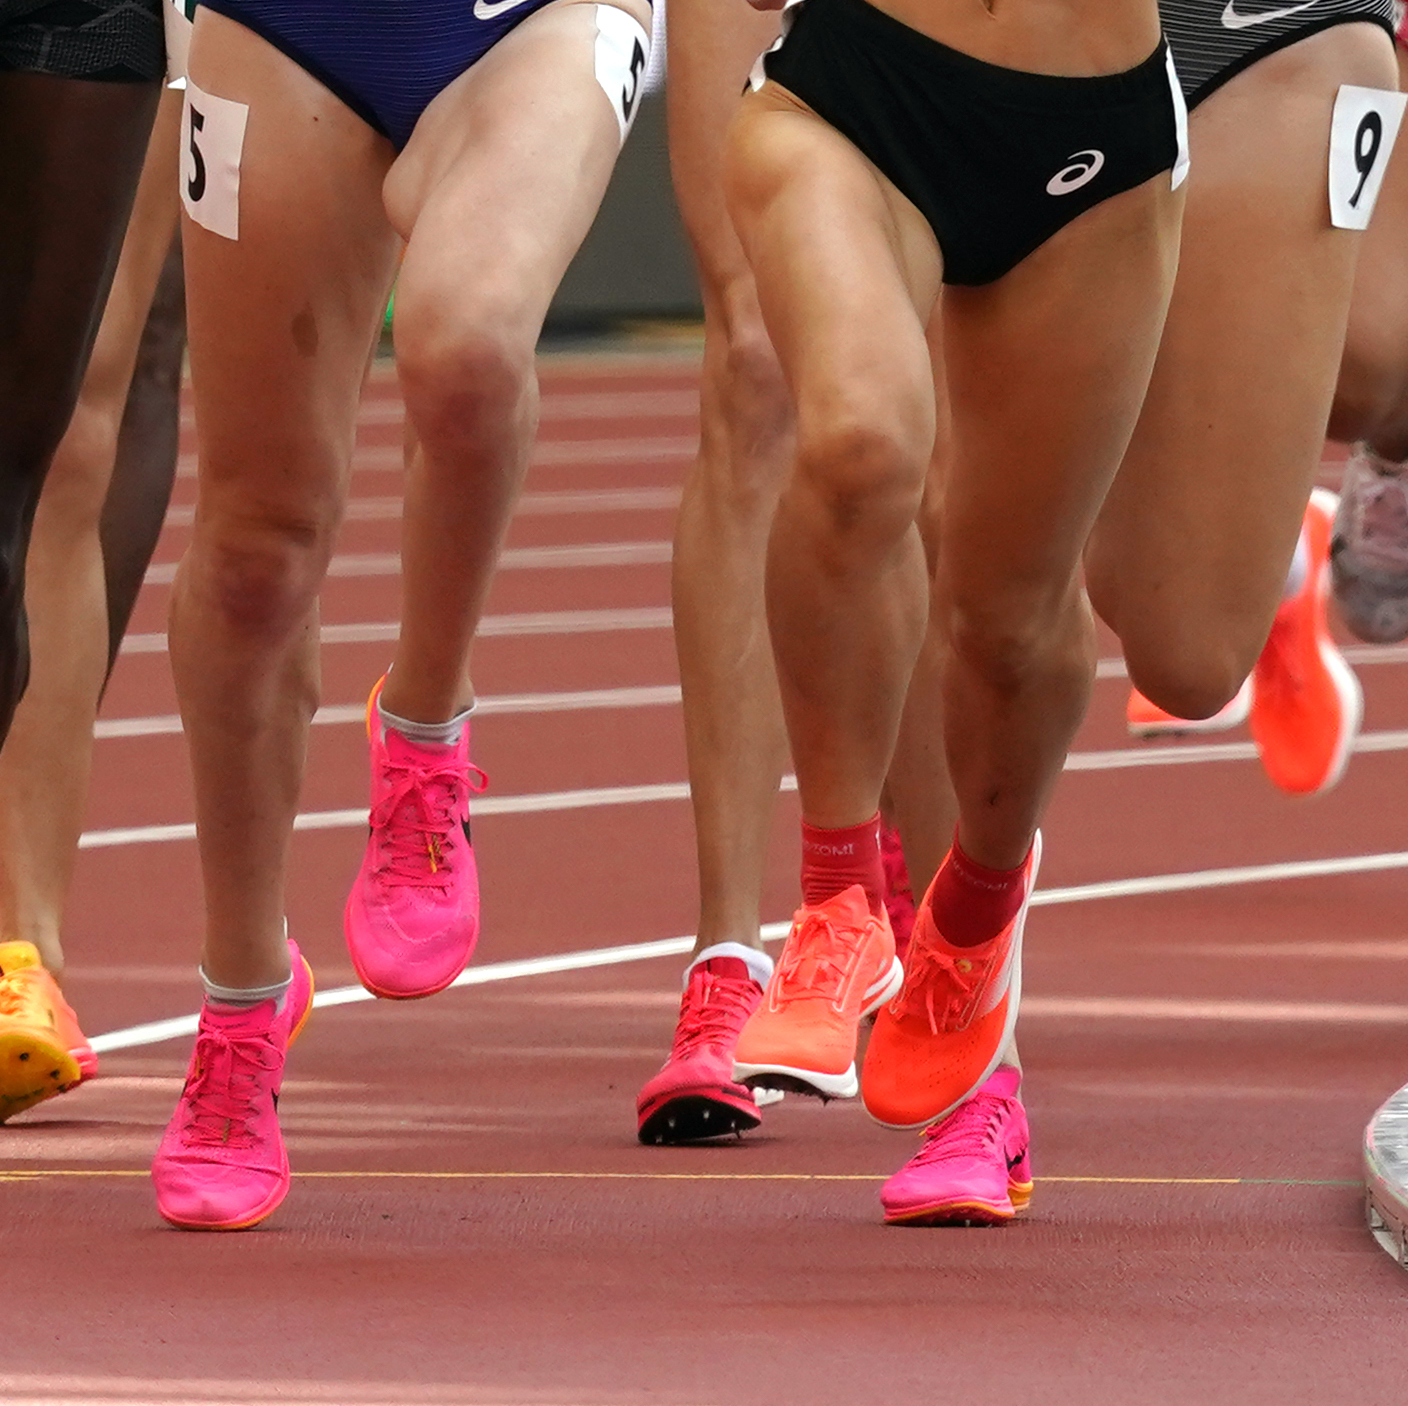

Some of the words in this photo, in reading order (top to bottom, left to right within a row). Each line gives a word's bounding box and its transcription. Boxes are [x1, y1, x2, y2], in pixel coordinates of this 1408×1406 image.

[622, 36, 645, 123] 5
[188, 102, 206, 203] 5
[1348, 110, 1383, 210] 9
